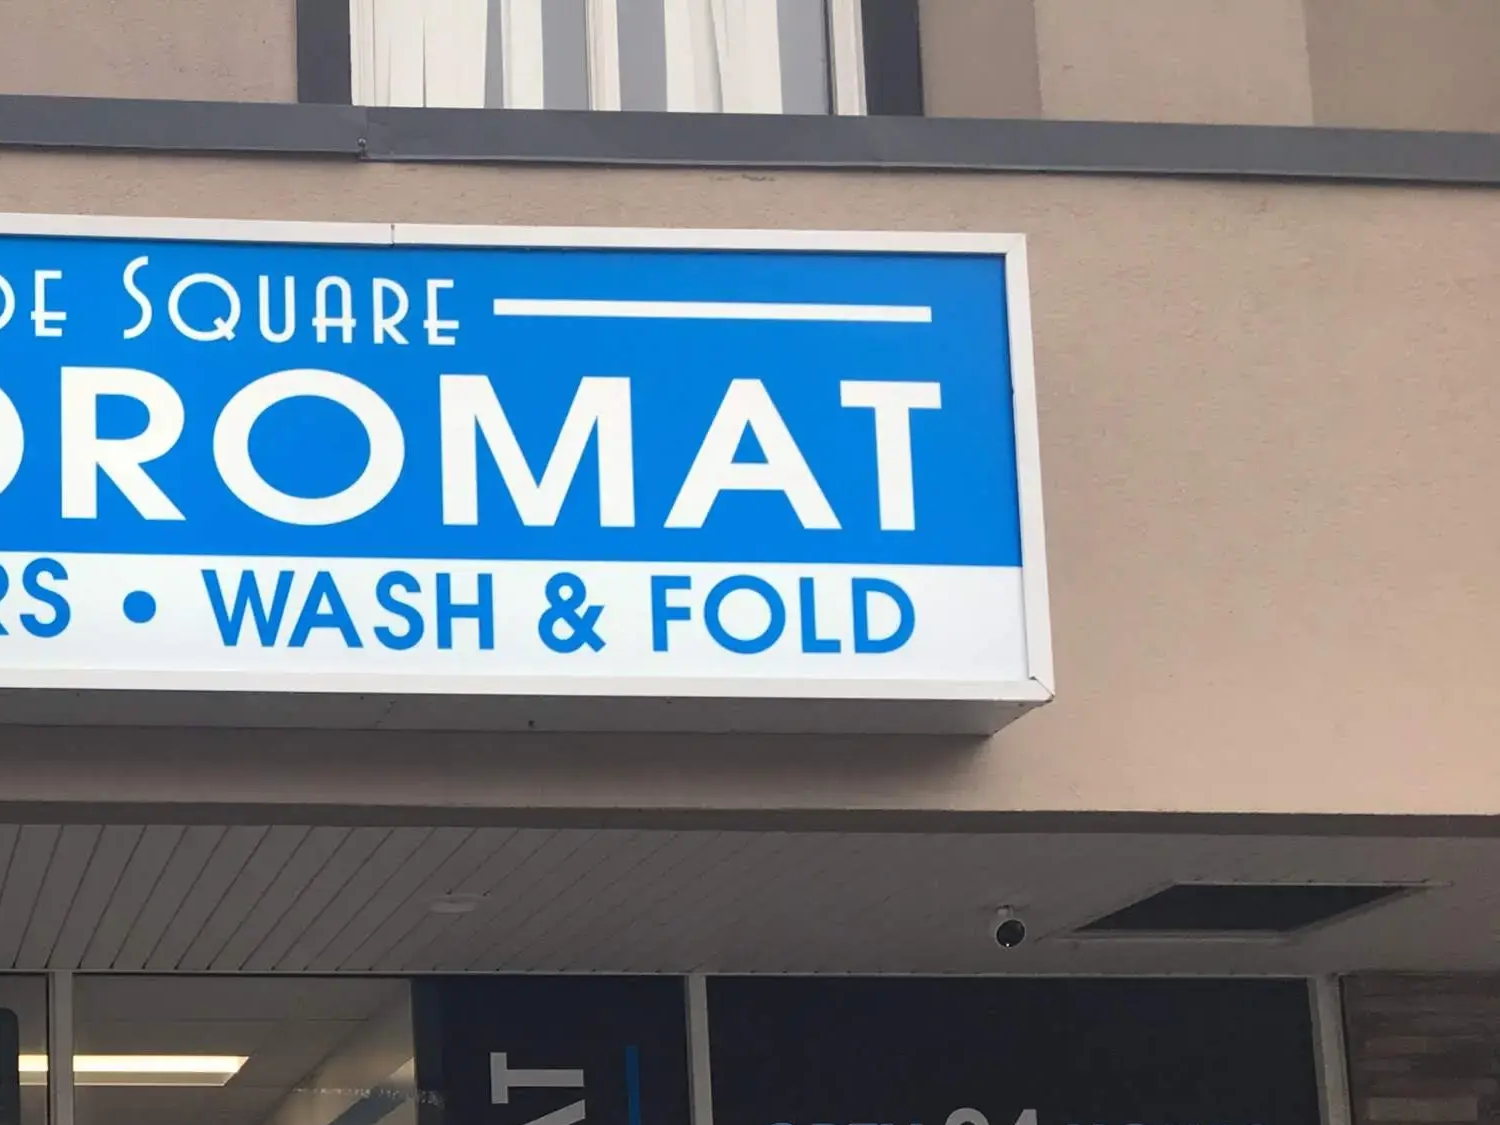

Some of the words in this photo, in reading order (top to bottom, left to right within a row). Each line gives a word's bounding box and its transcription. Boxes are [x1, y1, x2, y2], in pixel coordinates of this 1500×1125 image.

[124, 257, 458, 344] SQUARE
[202, 569, 494, 650] WASH
[538, 572, 605, 653] &
[651, 575, 915, 654] FOLD
